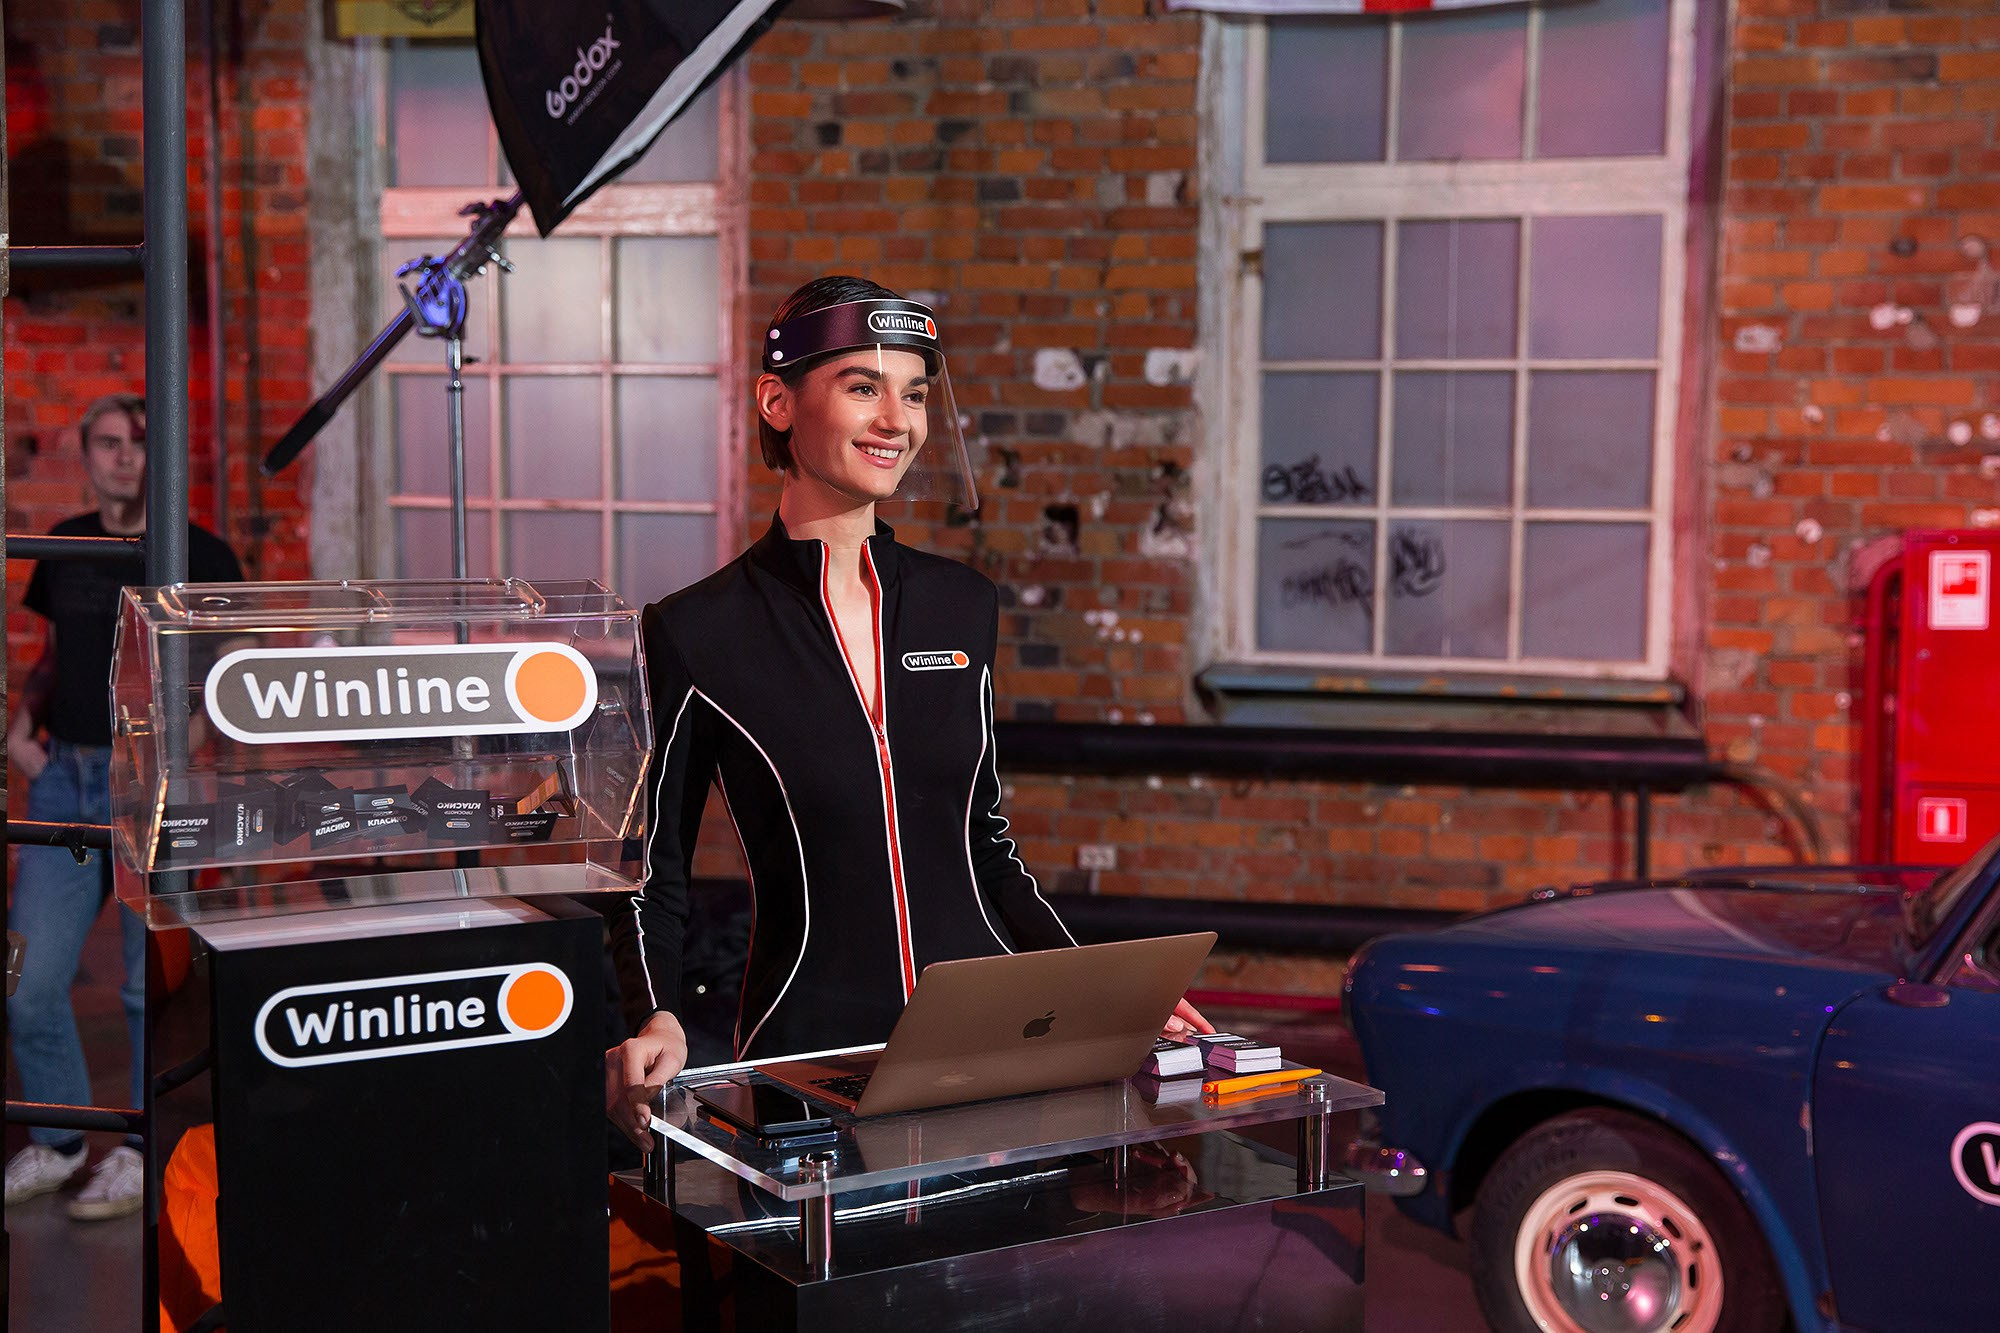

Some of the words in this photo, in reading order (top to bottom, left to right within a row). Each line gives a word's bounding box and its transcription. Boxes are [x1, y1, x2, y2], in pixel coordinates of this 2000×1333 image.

[875, 315, 925, 331] Winline
[907, 655, 952, 667] Winline
[242, 667, 491, 719] Winline
[437, 802, 481, 810] КЛАСИКО
[161, 818, 209, 828] КЛАСИКО
[236, 803, 244, 846] КЛАСИКО
[315, 820, 351, 837] КЛАСИКО
[285, 993, 487, 1047] Winline
